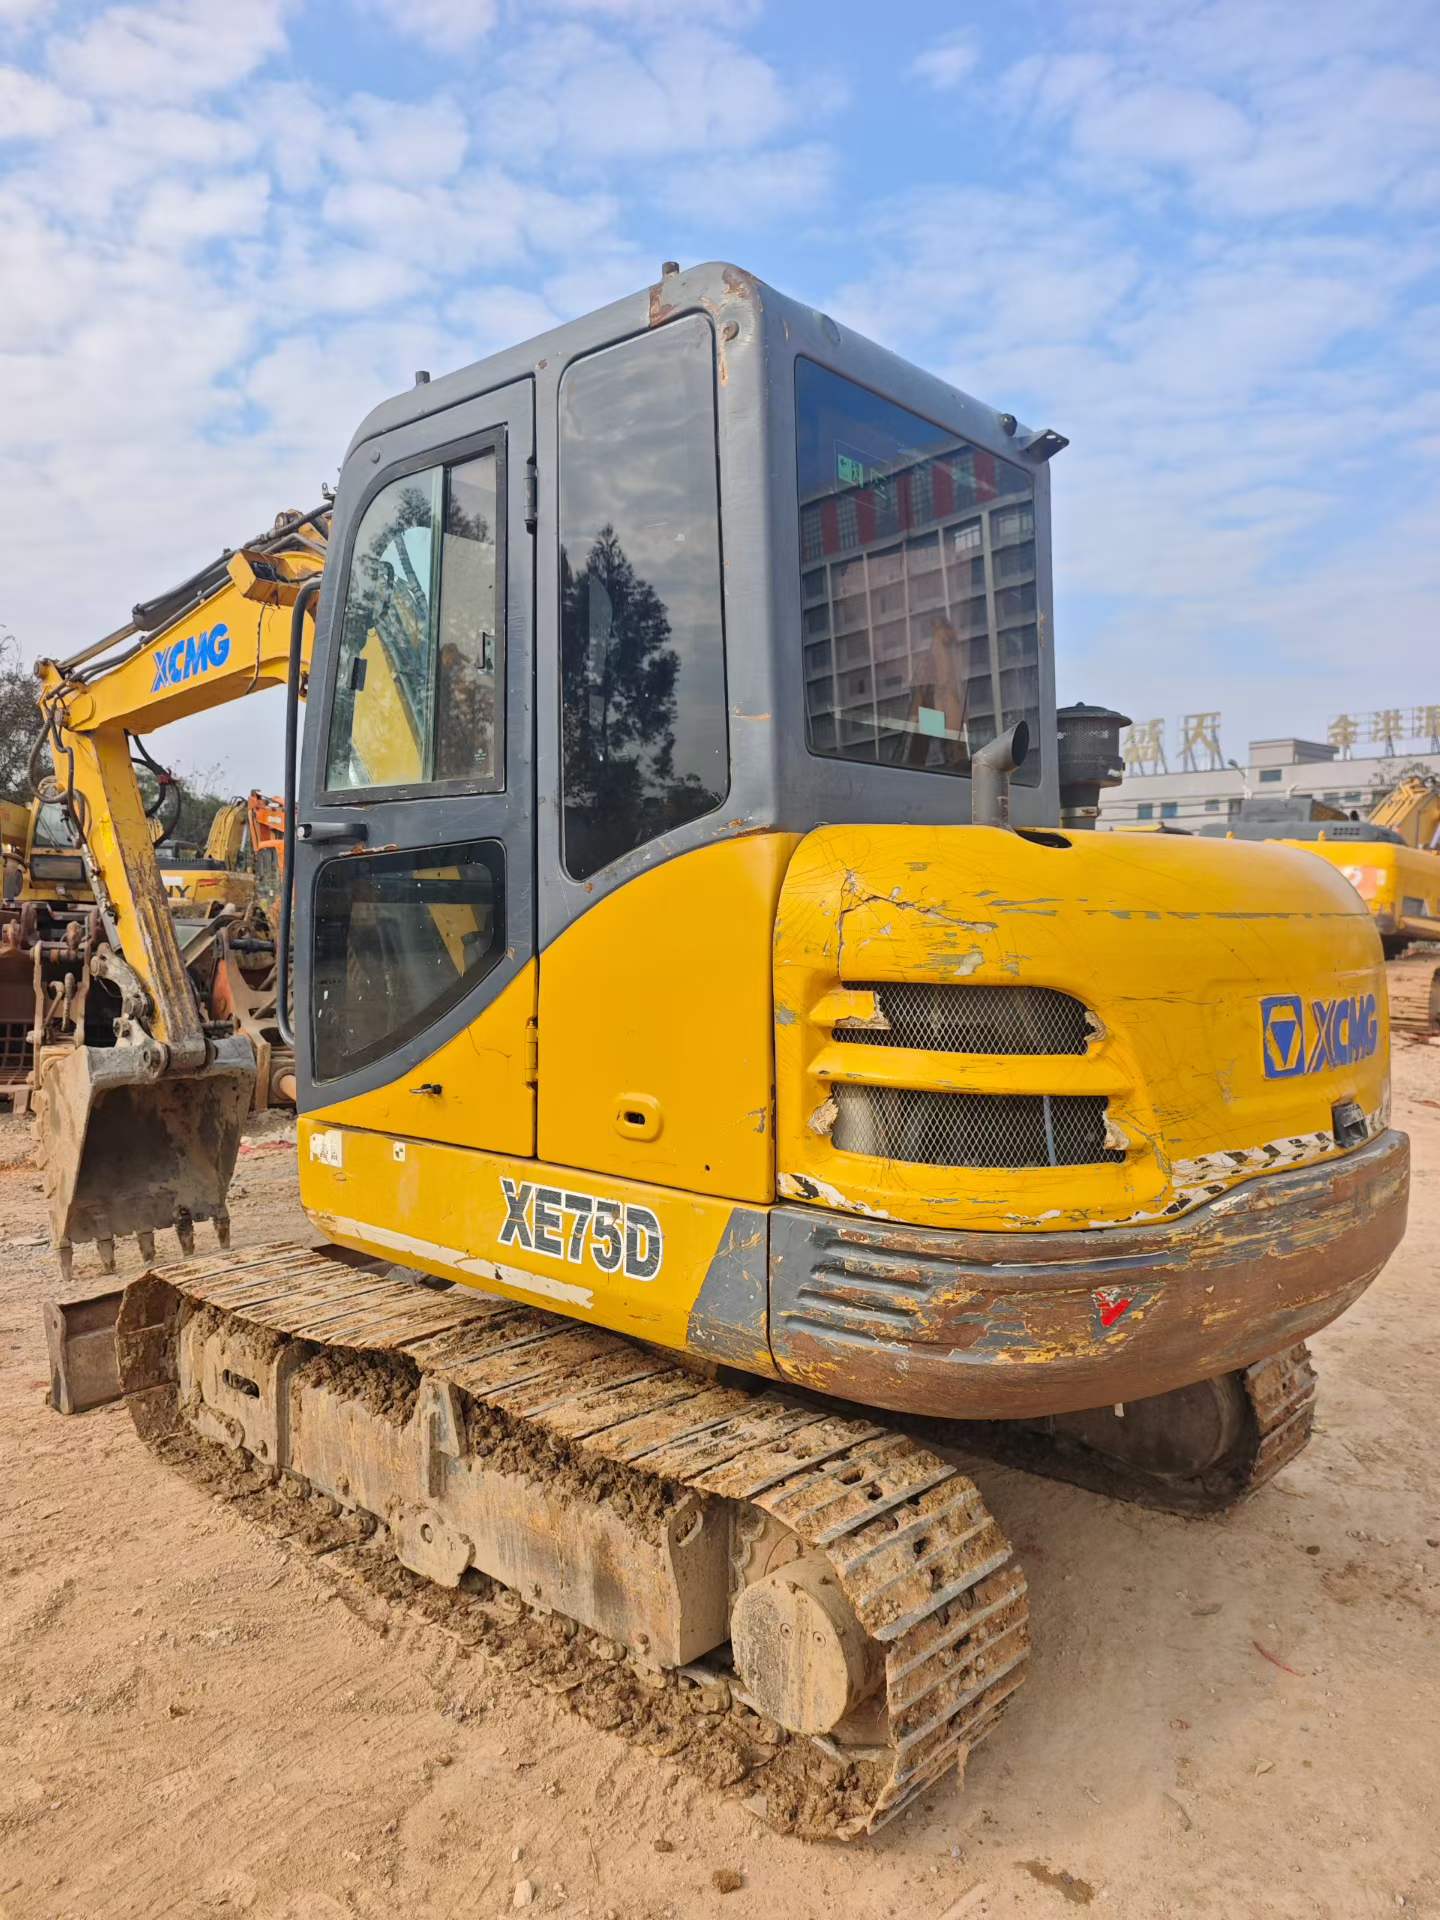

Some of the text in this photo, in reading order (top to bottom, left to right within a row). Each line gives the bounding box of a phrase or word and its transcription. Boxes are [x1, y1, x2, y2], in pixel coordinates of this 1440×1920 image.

[151, 623, 231, 693] XCMG
[1306, 994, 1378, 1073] XCMG
[498, 1176, 664, 1281] XE75D
